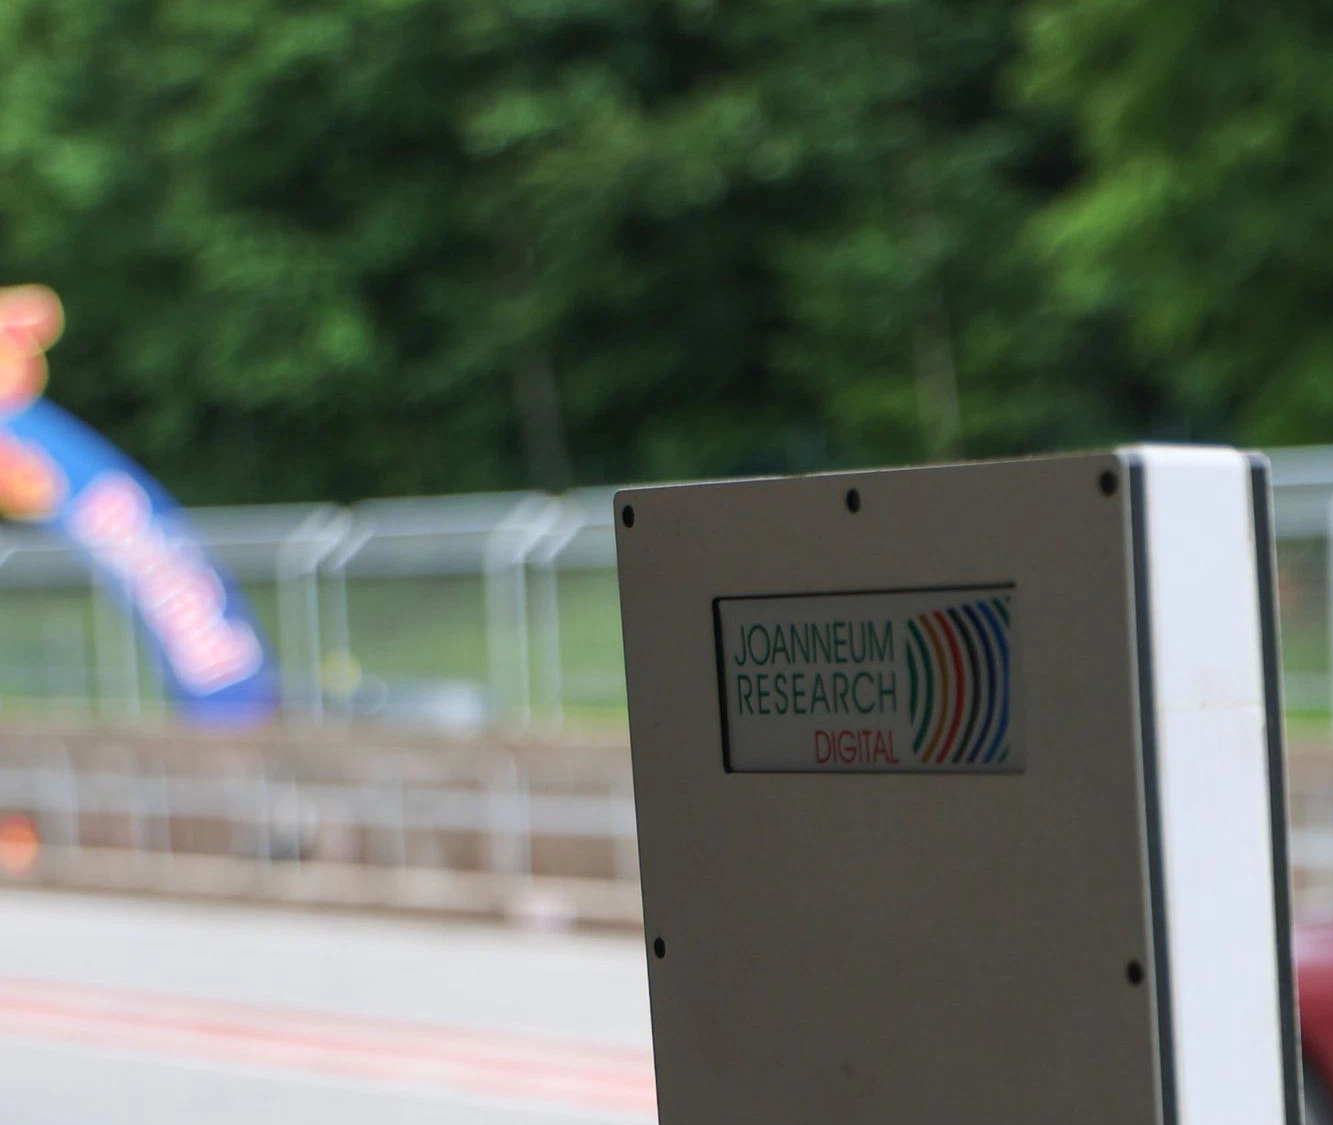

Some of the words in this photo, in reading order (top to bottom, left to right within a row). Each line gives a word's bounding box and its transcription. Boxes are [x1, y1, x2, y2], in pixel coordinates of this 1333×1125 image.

[735, 619, 895, 666] JOANNEUM
[737, 671, 897, 715] RESEARCH
[814, 728, 901, 764] DIGITAL
